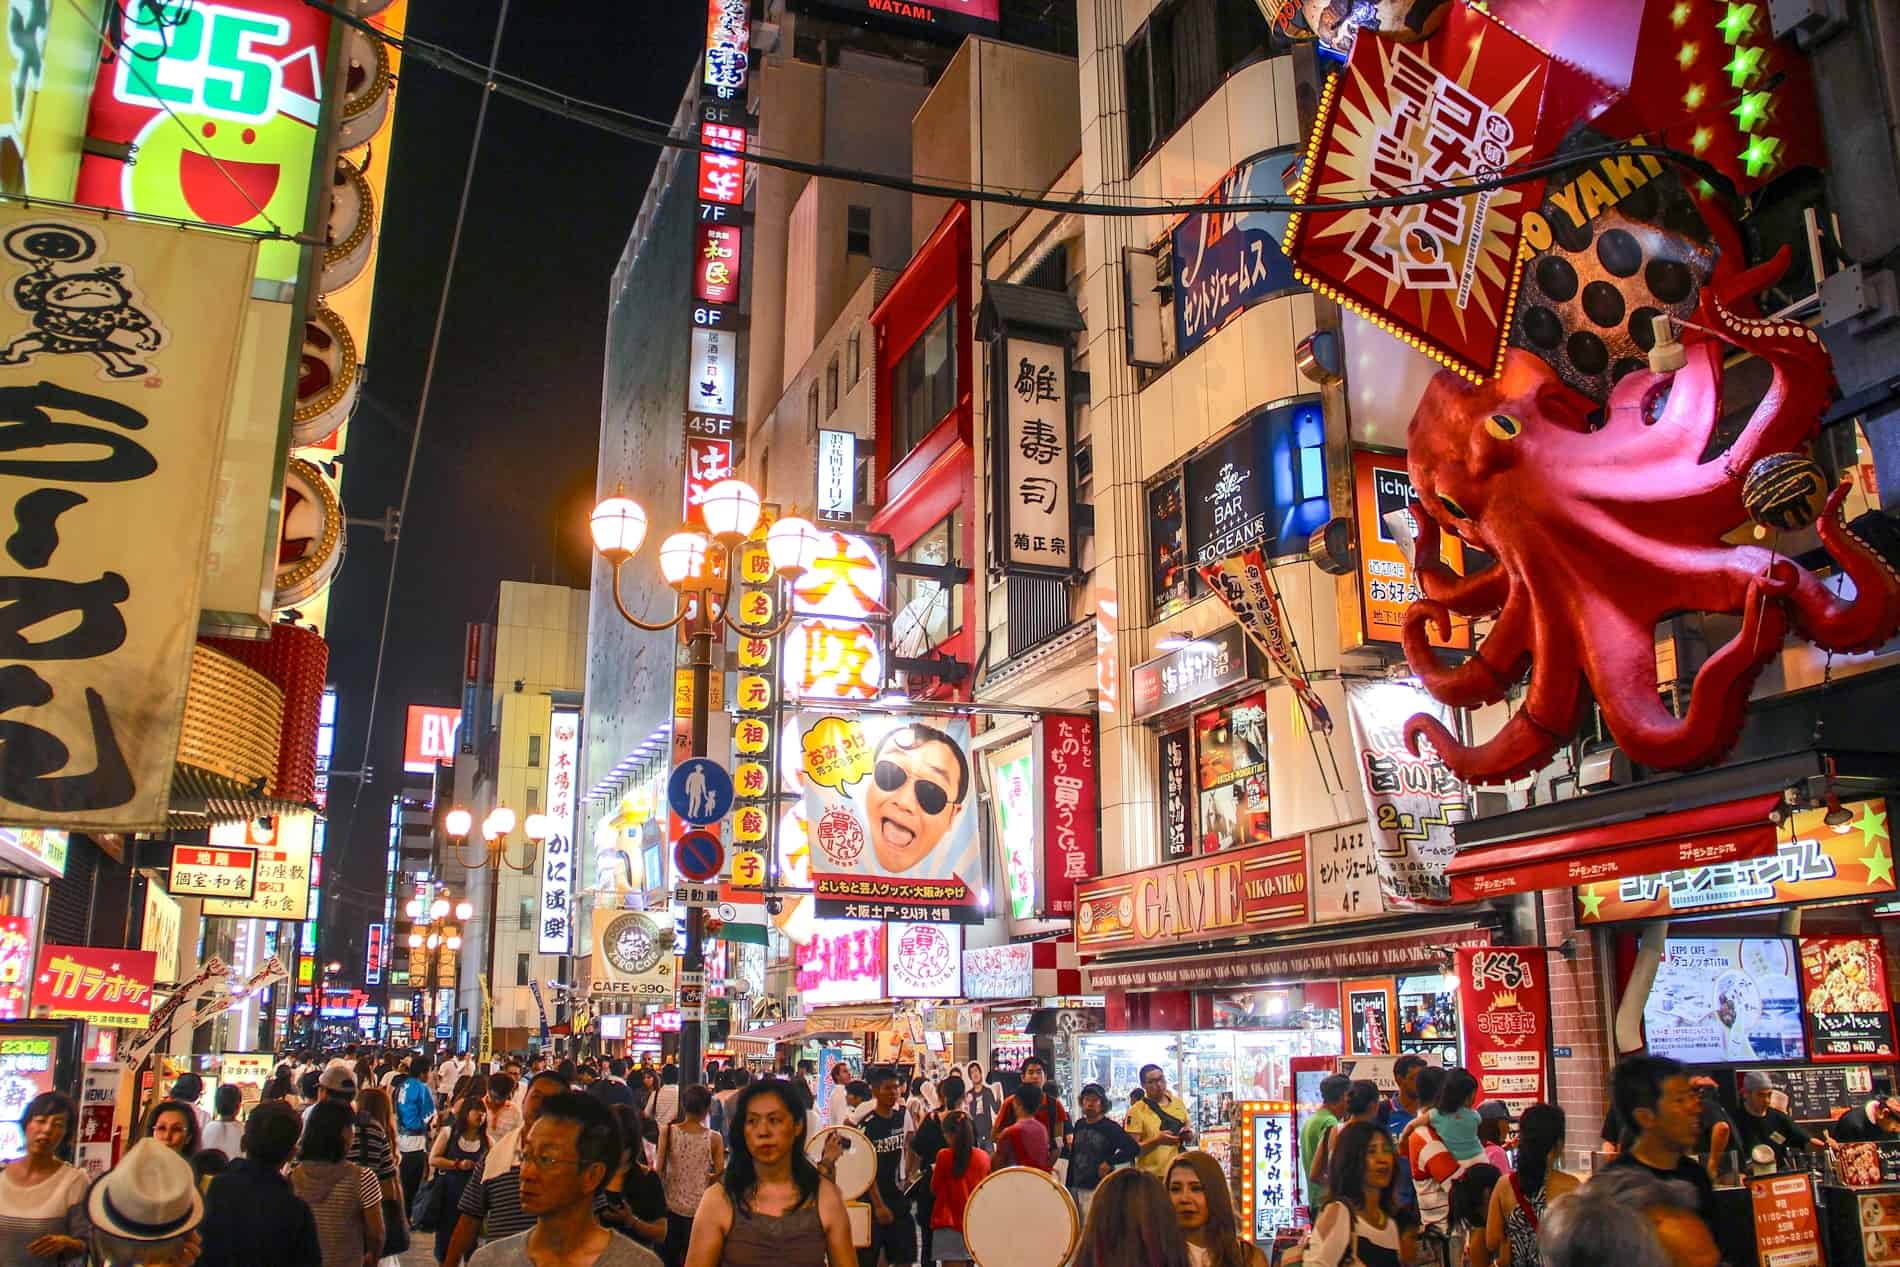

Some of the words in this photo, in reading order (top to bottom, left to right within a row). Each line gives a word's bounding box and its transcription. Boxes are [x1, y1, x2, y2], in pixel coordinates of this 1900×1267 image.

[867, 0, 932, 21] WATAMI
[122, 0, 278, 118] 25
[717, 87, 734, 98] 9F
[705, 107, 728, 120] 8F
[700, 206, 725, 220] 7F
[703, 240, 732, 284] 和民
[1184, 240, 1267, 336] セントジェームス
[694, 309, 721, 324] 6F
[824, 511, 847, 520] 4F
[1215, 496, 1243, 525] BAR
[1014, 533, 1066, 554] 菊正宗
[1371, 580, 1427, 601] お好み
[792, 531, 890, 698] 大阪
[1081, 723, 1093, 768] よしもと
[553, 752, 571, 818] 本場の味
[175, 871, 249, 891] 個室・和食
[543, 832, 570, 940] かに道楽
[818, 879, 966, 900] よしもと芸人グッズ・大阪みやげ
[1245, 871, 1305, 900] NIKO-NIKO
[676, 887, 718, 902] 自動車
[1136, 860, 1244, 938] GAME
[1341, 890, 1360, 913] 4F
[48, 955, 151, 1004] カラオケ
[658, 964, 672, 976] 2F
[1483, 953, 1523, 988] くくる
[592, 982, 630, 993] CAFE
[1477, 1012, 1537, 1034] 3冠達成
[1263, 1118, 1284, 1207] お好み焼
